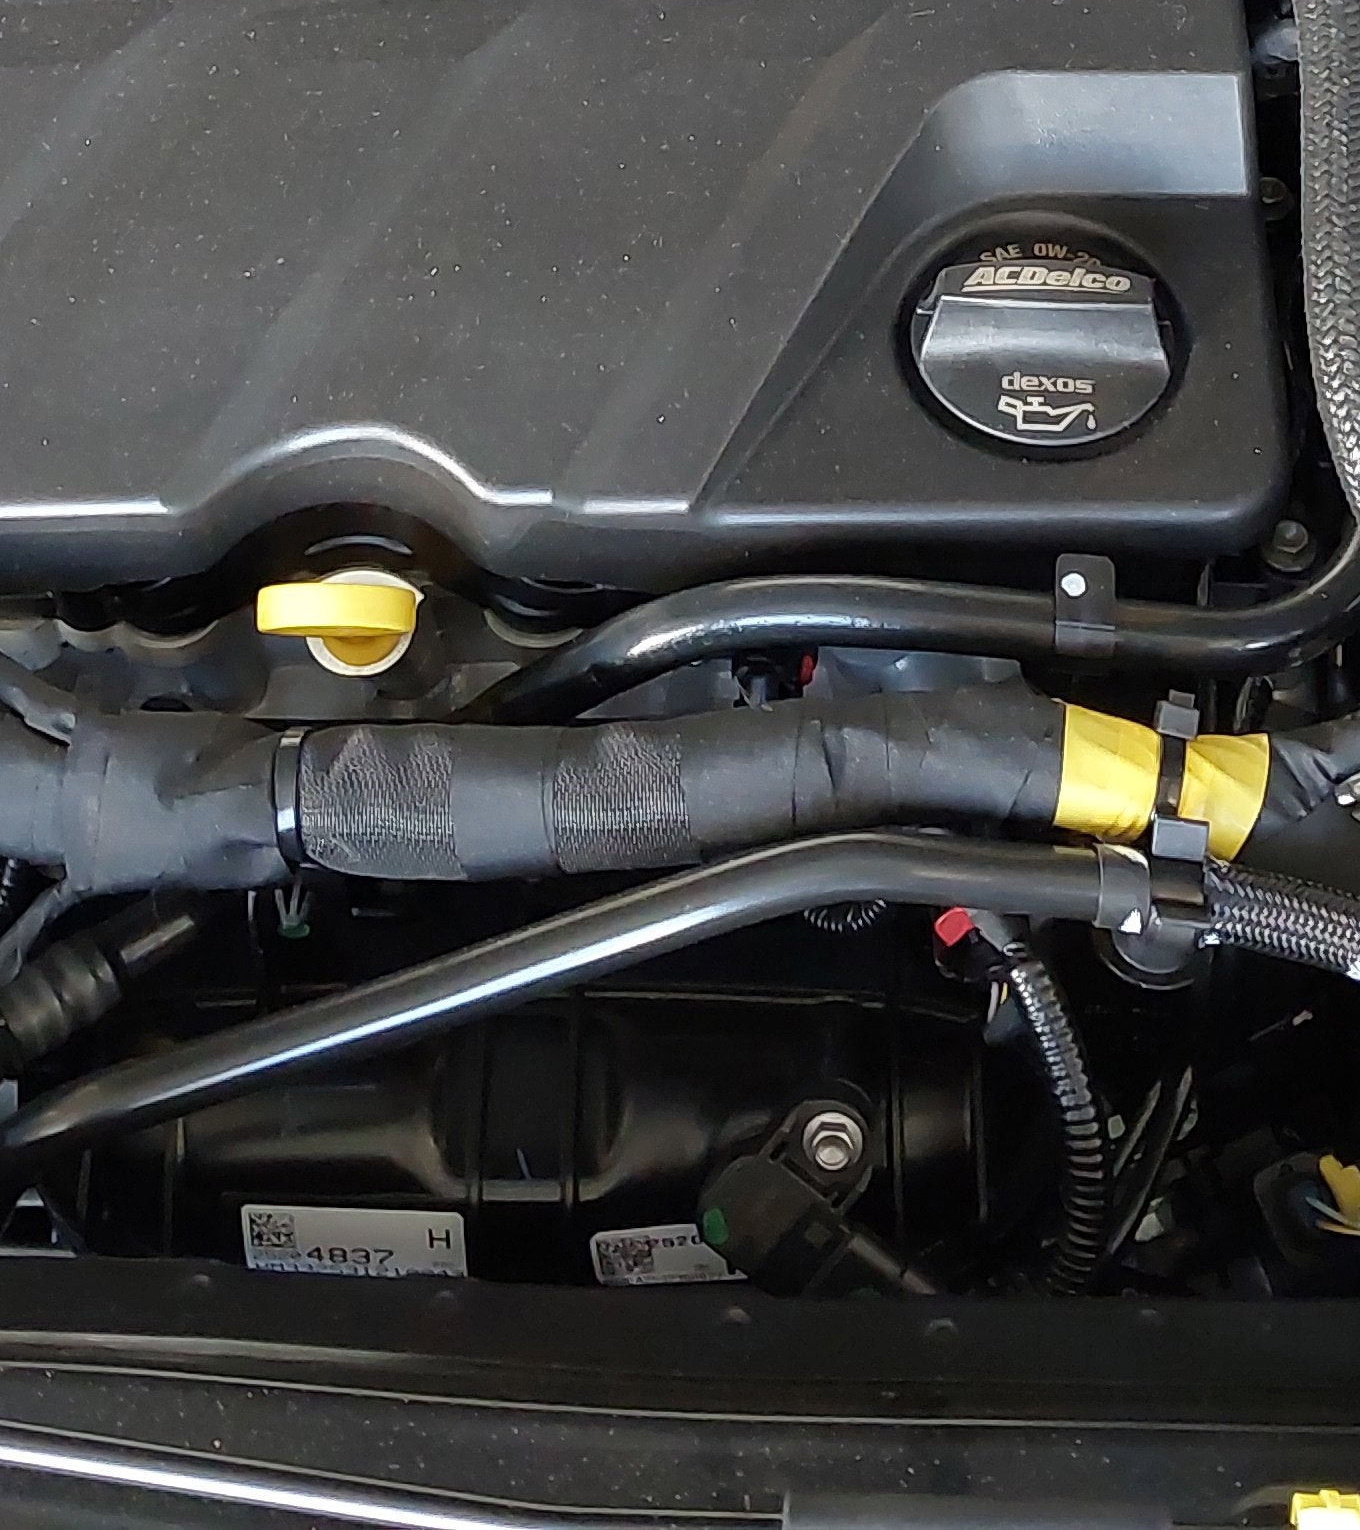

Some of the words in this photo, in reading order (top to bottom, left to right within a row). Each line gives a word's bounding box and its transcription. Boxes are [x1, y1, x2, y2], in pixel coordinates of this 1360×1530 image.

[980, 244, 1021, 261] SAE
[962, 266, 1131, 292] ACDelco
[1001, 372, 1096, 393] dexos
[427, 1228, 451, 1249] H
